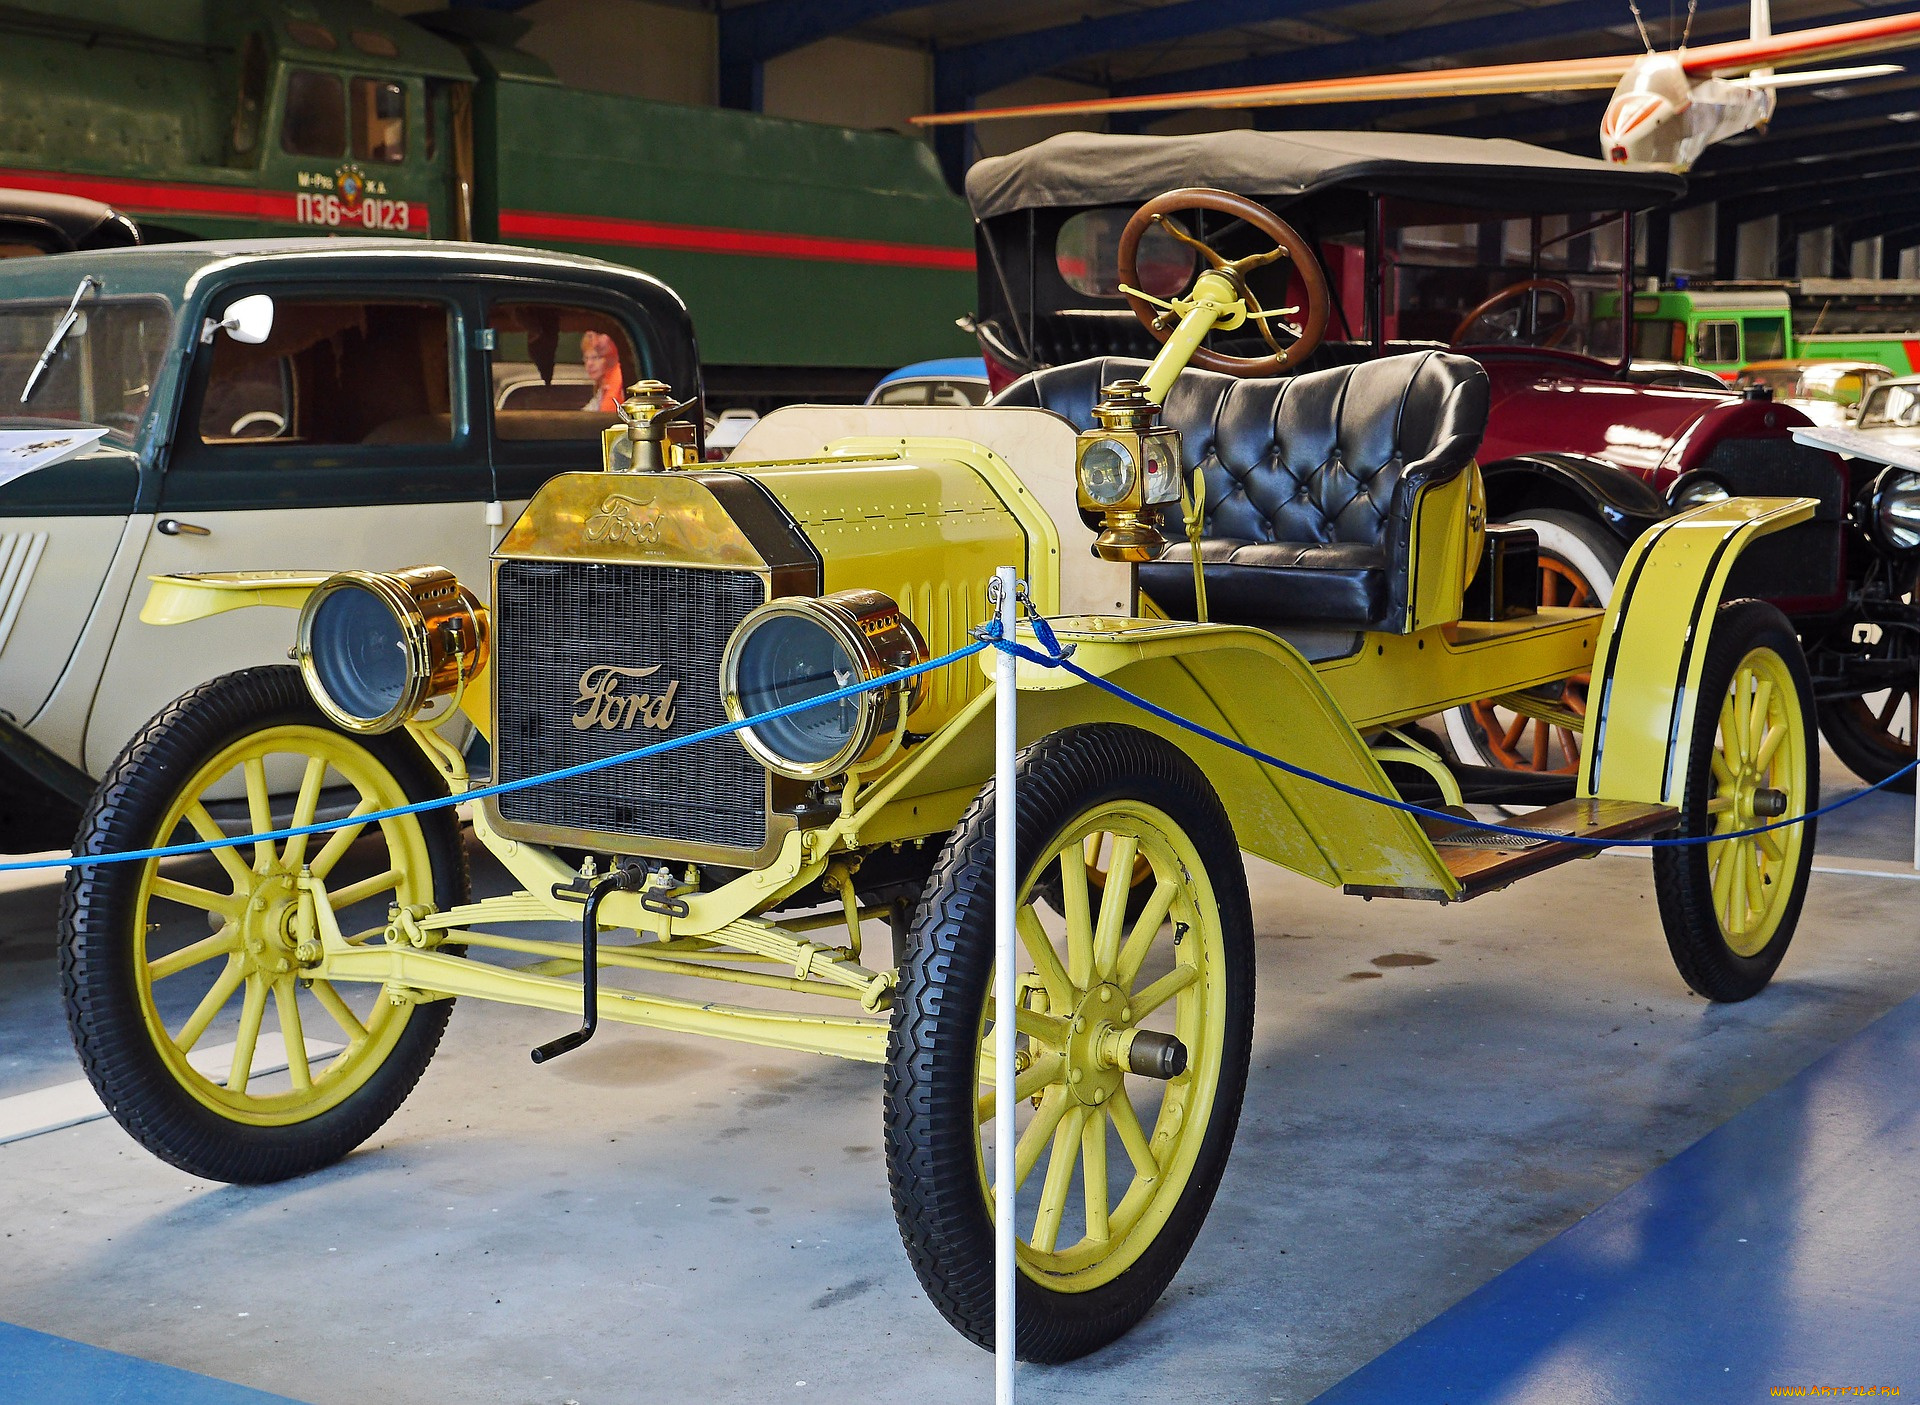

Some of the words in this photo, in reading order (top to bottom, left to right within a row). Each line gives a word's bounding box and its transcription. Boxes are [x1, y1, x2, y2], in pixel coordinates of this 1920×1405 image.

[363, 198, 409, 230] 0123
[585, 493, 664, 543] Ford
[572, 664, 679, 730] Ford
